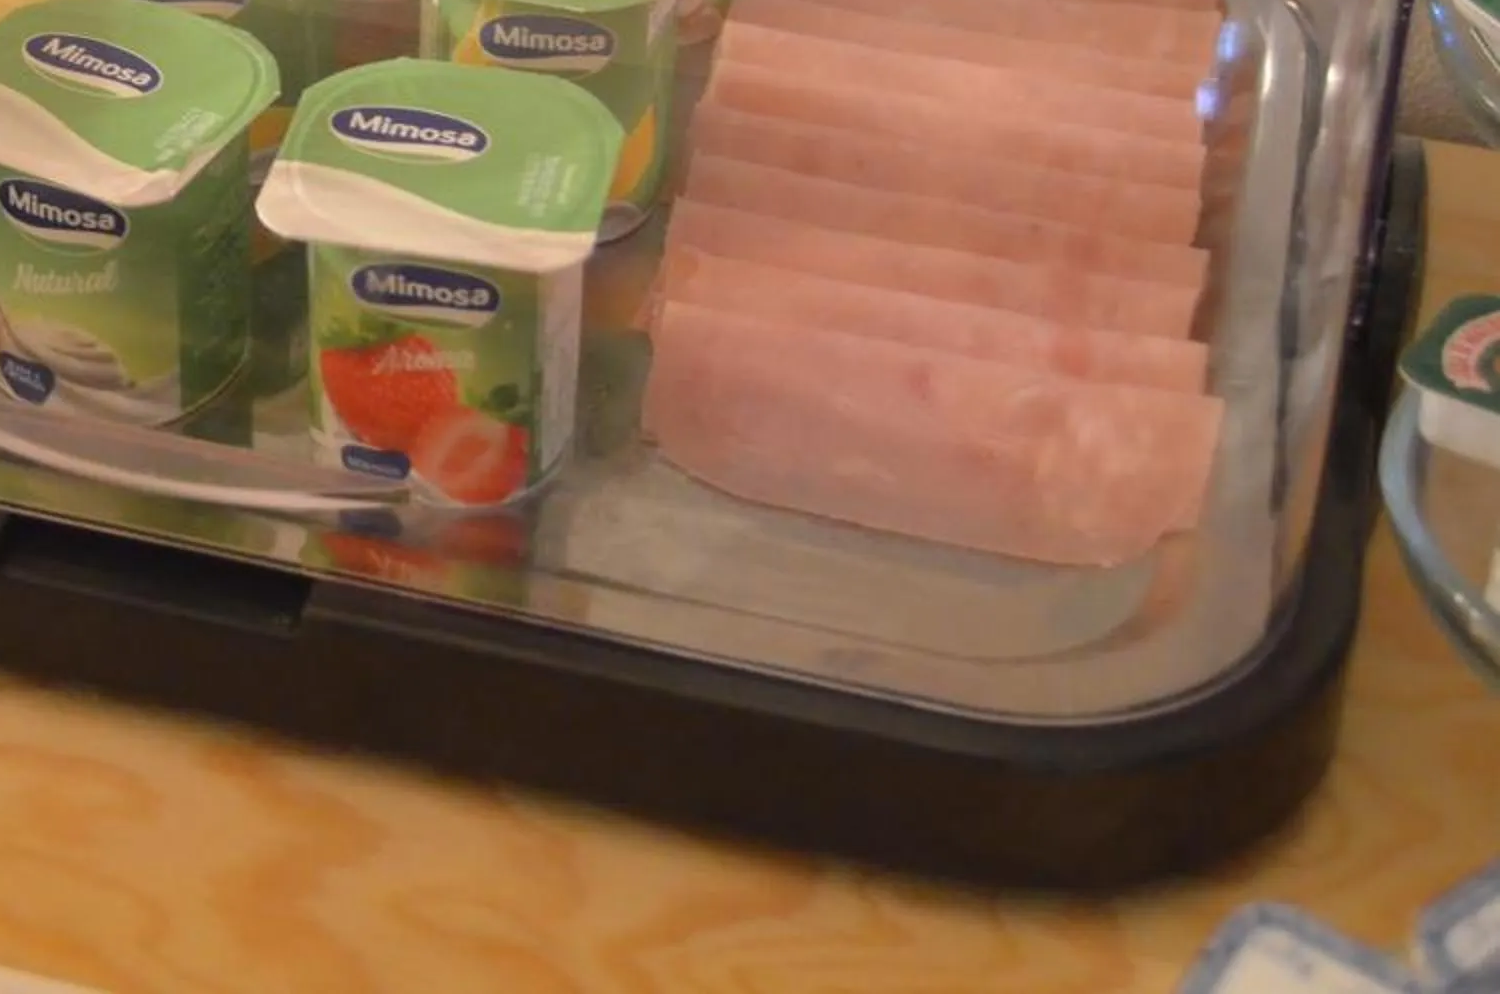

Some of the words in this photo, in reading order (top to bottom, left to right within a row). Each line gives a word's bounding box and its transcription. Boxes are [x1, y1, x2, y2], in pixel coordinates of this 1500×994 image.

[493, 24, 607, 52] Mimosa
[42, 37, 153, 89] Mimosa
[349, 111, 479, 148] Mimosa
[8, 185, 118, 232] Mimosa
[12, 260, 120, 295] Natural
[364, 268, 491, 308] Mimosa
